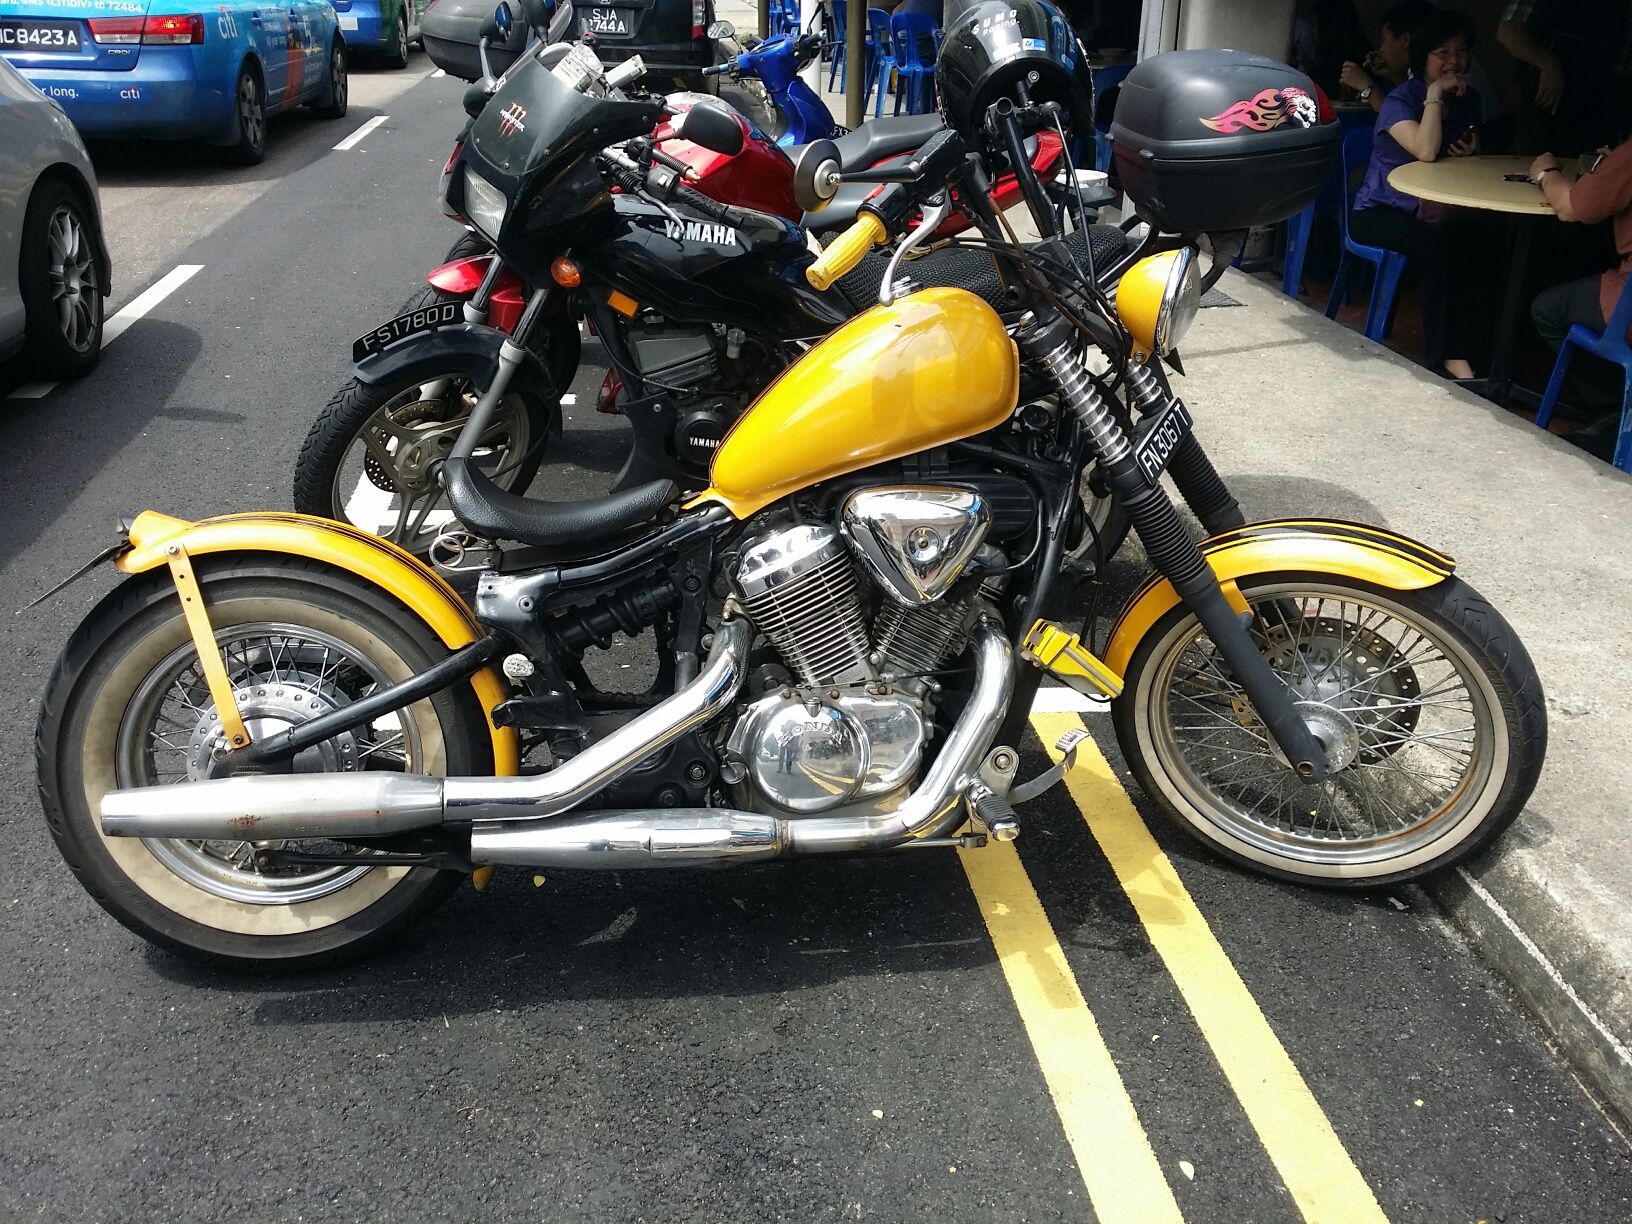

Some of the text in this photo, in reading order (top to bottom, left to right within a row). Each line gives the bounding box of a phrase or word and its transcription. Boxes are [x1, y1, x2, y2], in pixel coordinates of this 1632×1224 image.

[95, 1, 105, 9] to
[107, 2, 145, 13] 72484.
[592, 8, 617, 21] SJA
[218, 9, 238, 39] citi
[50, 86, 79, 99] long.
[120, 86, 140, 99] citi
[362, 304, 455, 351] FS1780D
[689, 436, 720, 448] YAMAHA
[1140, 403, 1188, 478] FN3067T
